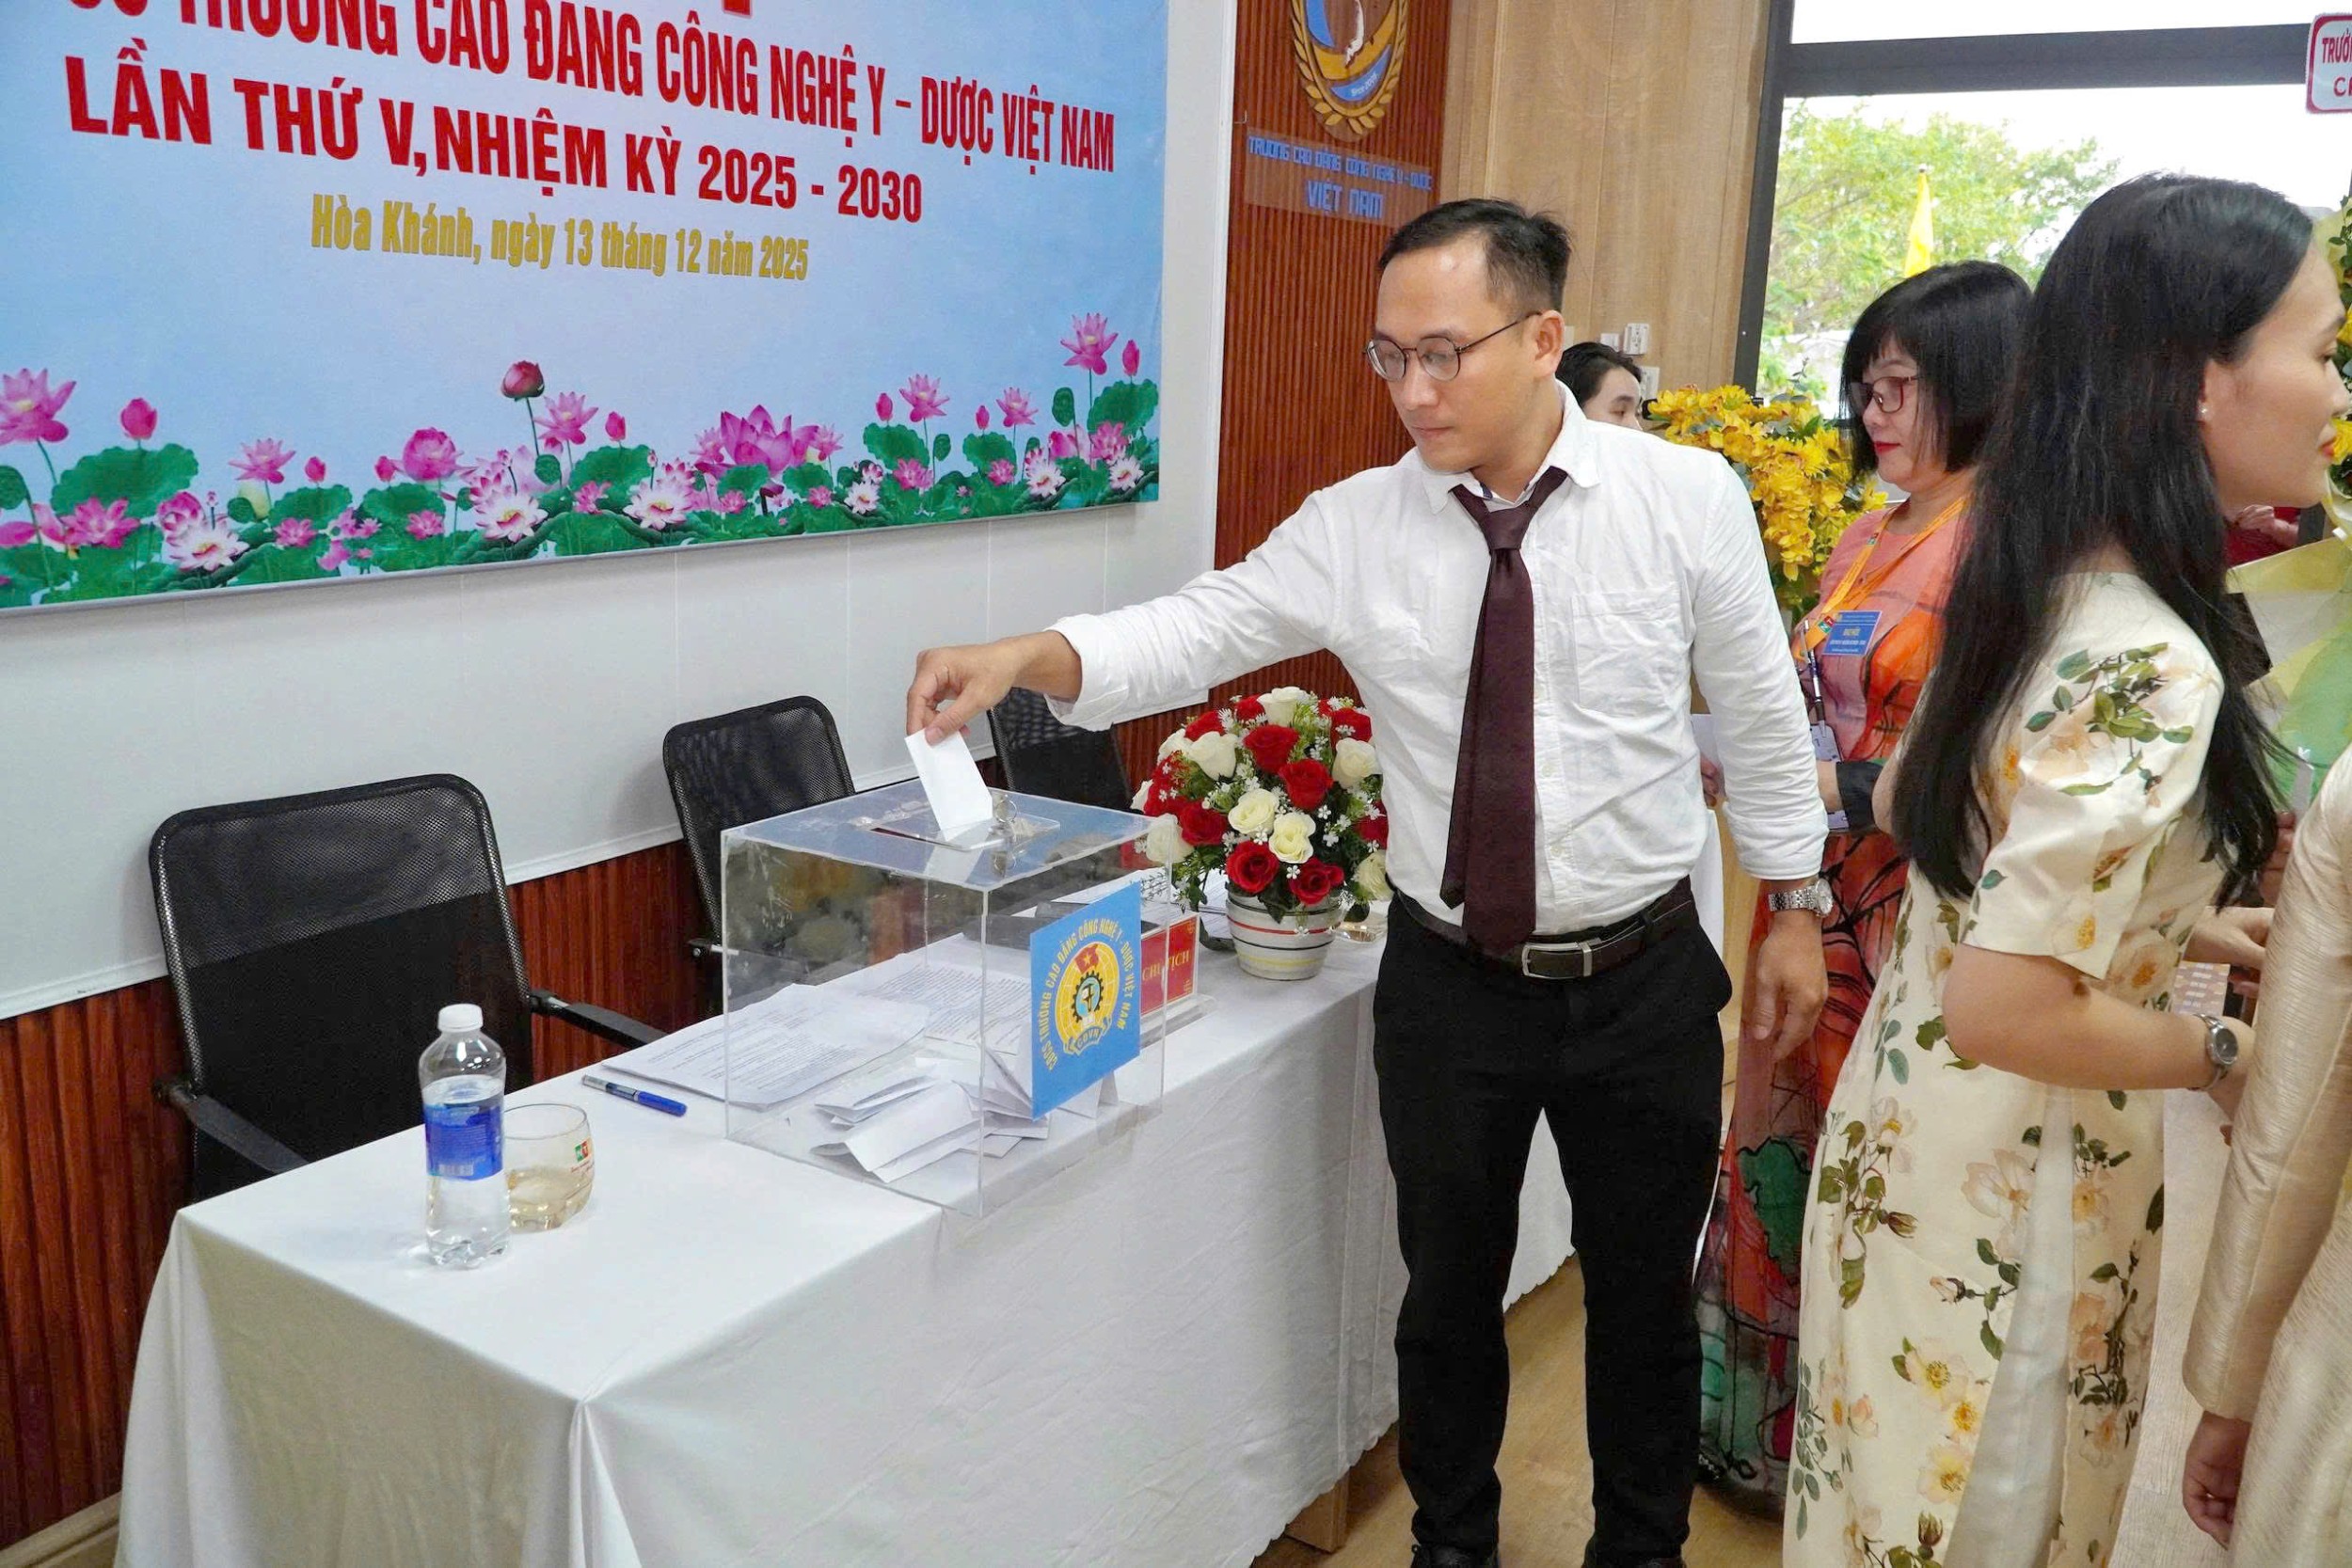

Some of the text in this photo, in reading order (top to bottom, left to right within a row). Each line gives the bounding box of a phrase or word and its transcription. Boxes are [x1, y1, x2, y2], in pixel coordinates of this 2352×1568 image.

[65, 38, 212, 145] LẦN
[233, 76, 363, 161] THỨ
[625, 125, 681, 196] KỲ
[698, 145, 797, 209] 2025
[811, 184, 823, 196] -
[837, 165, 922, 223] 2030
[416, 0, 510, 74] CAO
[656, 10, 758, 116] CÔNG
[770, 44, 858, 148] NGHỆ
[866, 65, 885, 135] Y
[921, 75, 993, 166] DƯỢC
[1002, 84, 1055, 175] VIỆT
[1061, 105, 1114, 172] NAM
[311, 193, 809, 280] Hòa Khánh, ngày 13 tháng 12 năm 2025
